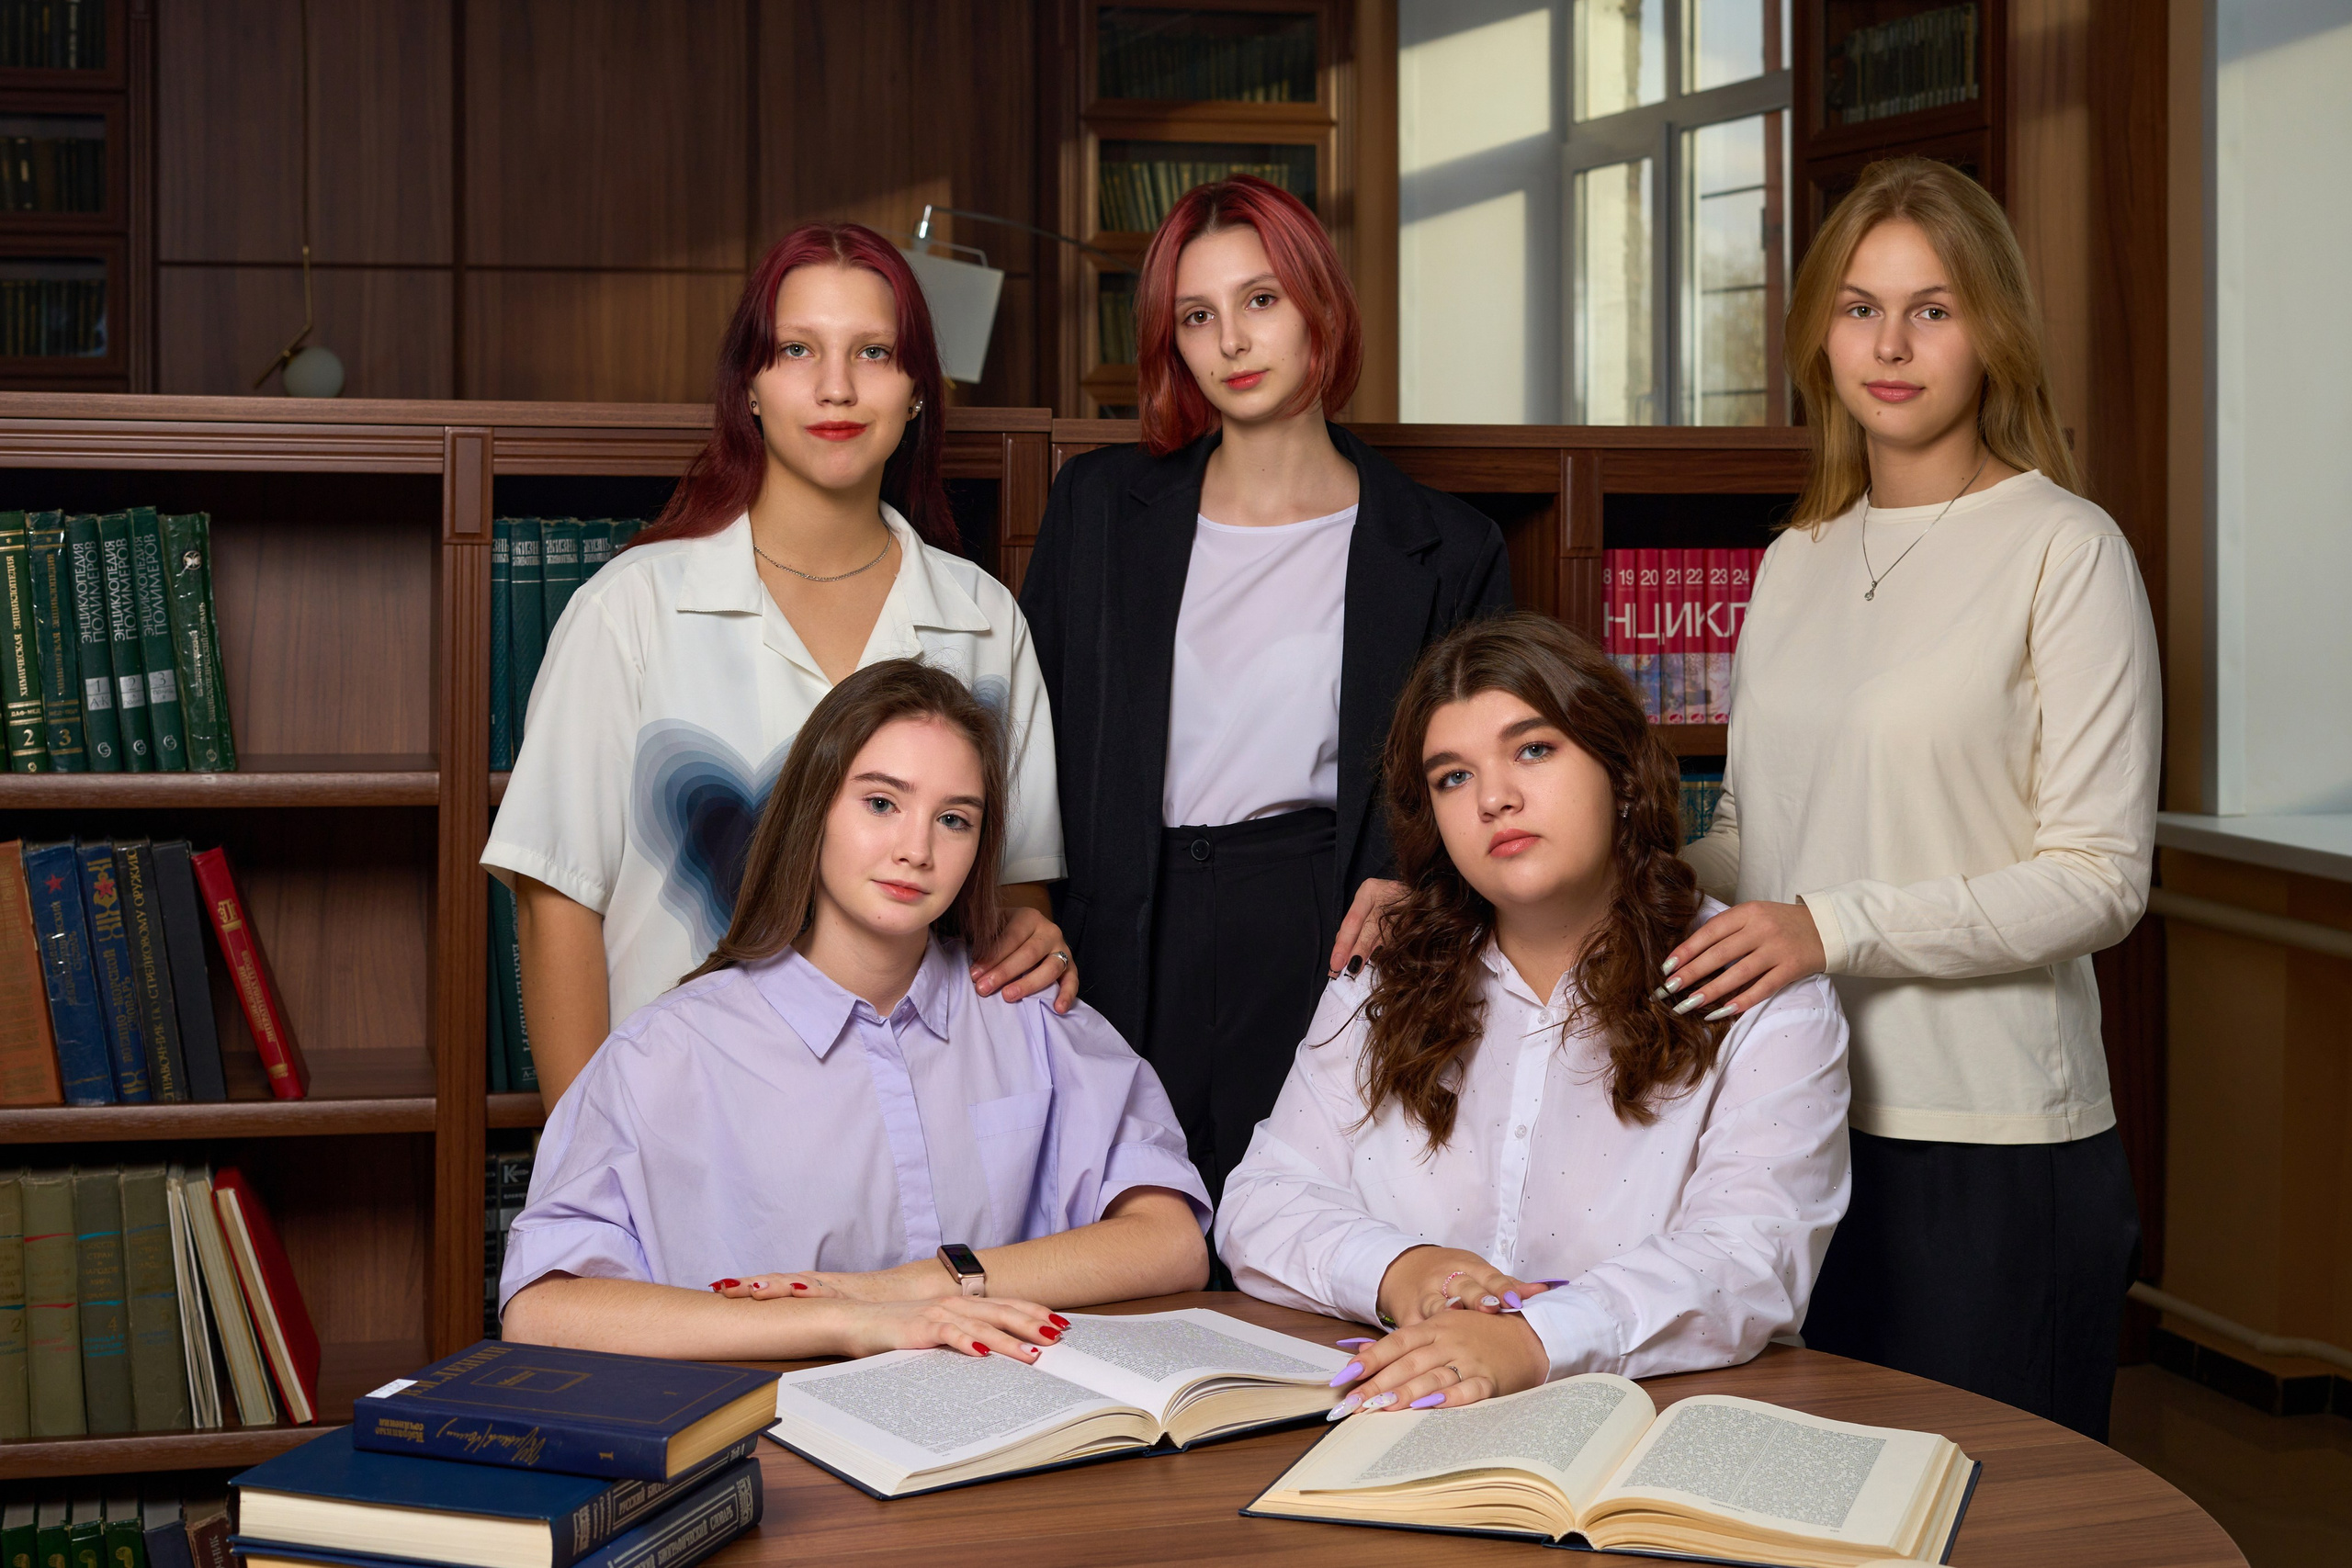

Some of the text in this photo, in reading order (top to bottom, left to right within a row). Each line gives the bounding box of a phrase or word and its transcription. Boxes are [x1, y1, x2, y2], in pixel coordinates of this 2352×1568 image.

[143, 534, 167, 635] ПОЛИМЕРОВ
[1619, 569, 1634, 585] 19
[1640, 570, 1659, 585] 20
[1666, 569, 1681, 584] 21
[1686, 569, 1703, 584] 22
[1710, 569, 1728, 584] 23
[1733, 569, 1750, 584] 24
[73, 543, 93, 643] ЭНЦИКЛОПЕДИЯ
[85, 541, 106, 643] ПОЛИМЕРОВ
[105, 540, 126, 641] ЭНЦИКЛОПЕДИЯ
[116, 538, 138, 640] ПОЛИМЕРОВ
[134, 536, 154, 637] ЭНЦИКЛОПЕДИЯ
[6, 556, 28, 696] ХИМИЧЕСКАЯ ЭНЦИКЛОПЕДИЯ
[95, 680, 101, 693] 1
[128, 677, 136, 691] 2
[158, 672, 166, 685] 3
[23, 728, 35, 746] 2
[59, 728, 72, 746] 3
[135, 910, 160, 998] СТРЕЛКОВОМУ
[120, 976, 138, 1031] СЛОВАРЬ
[150, 1000, 163, 1020] ПО
[11, 1317, 22, 1333] 2
[107, 1315, 117, 1331] 4
[618, 1486, 645, 1515] РУССКИЙ
[658, 1519, 708, 1565] БИОГРАФИЧЕСКИЙ
[709, 1505, 734, 1530] СЛОВАРЬ
